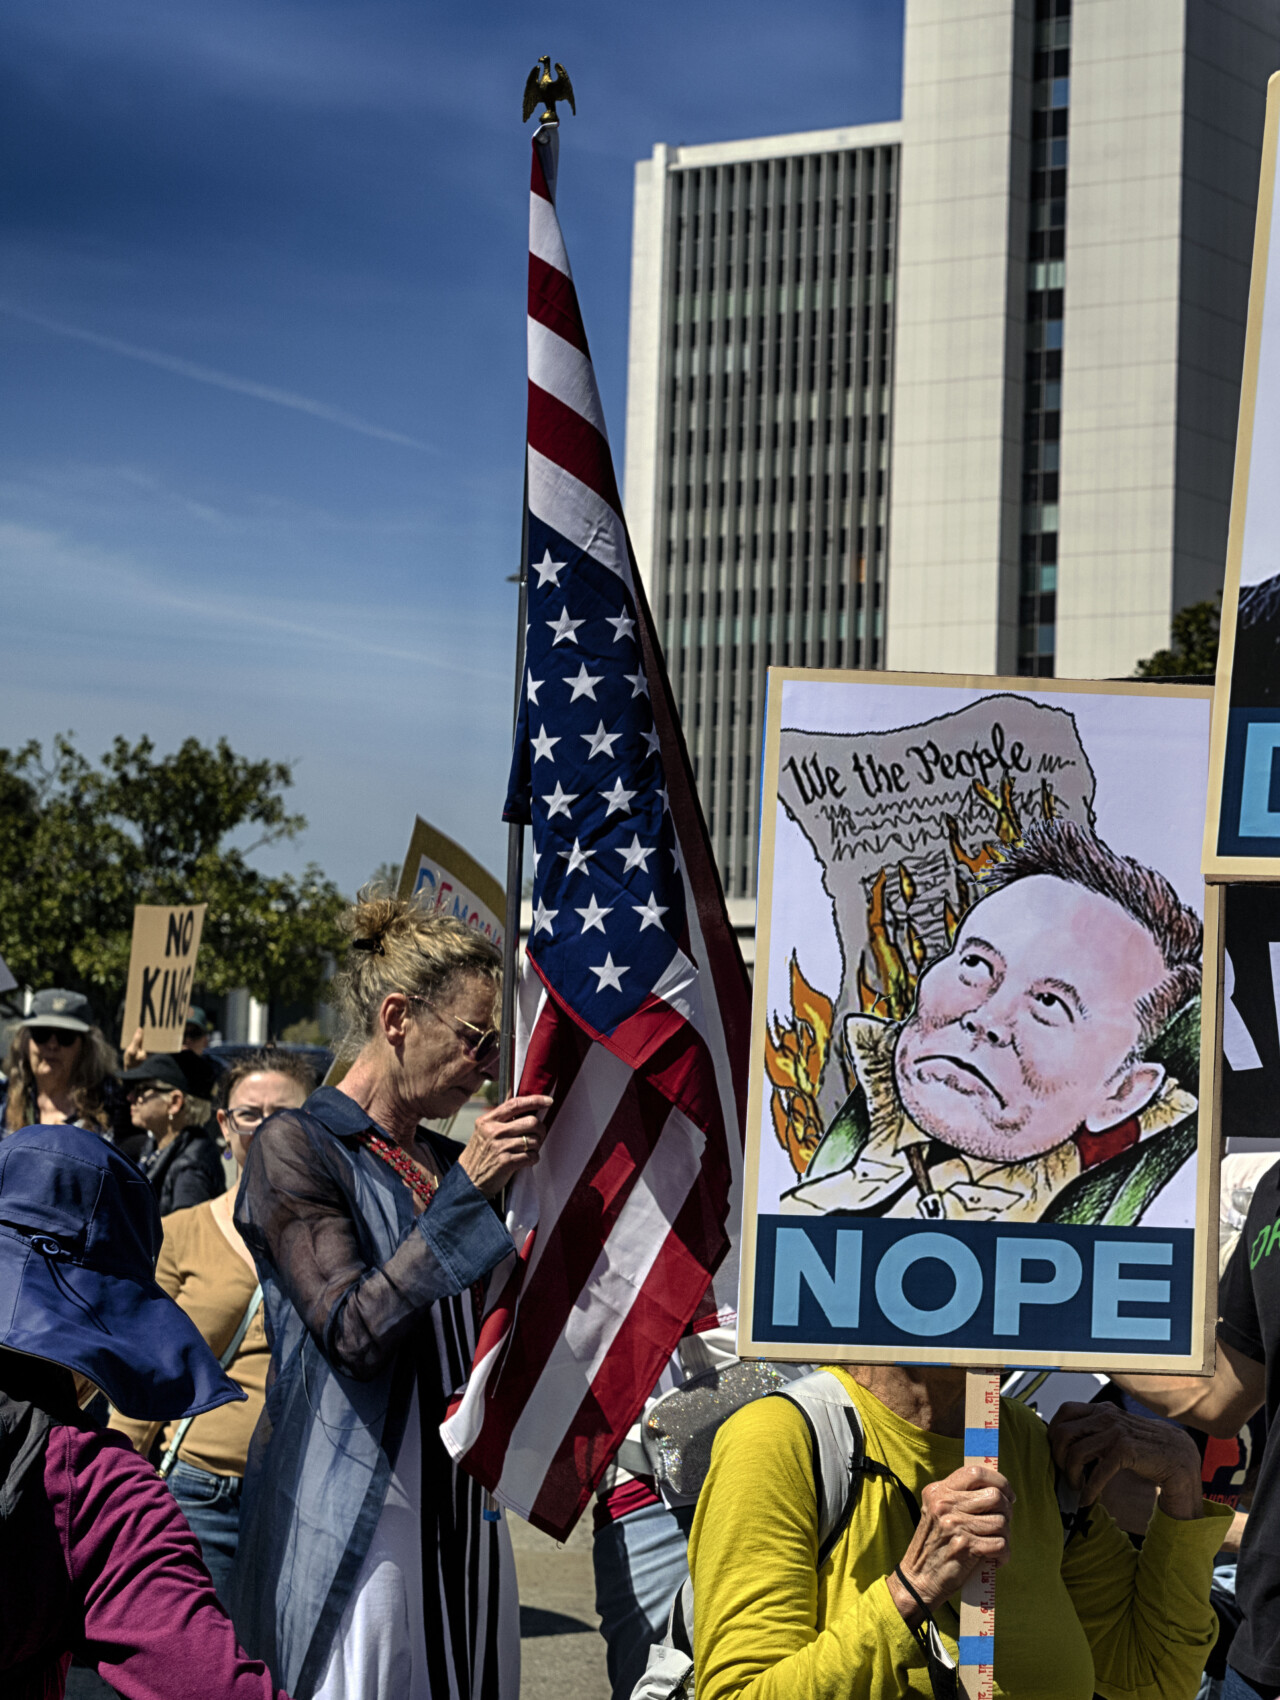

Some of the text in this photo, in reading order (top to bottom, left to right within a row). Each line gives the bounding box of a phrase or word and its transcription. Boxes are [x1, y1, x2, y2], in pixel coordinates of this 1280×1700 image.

[782, 723, 1031, 805] We the People
[165, 910, 194, 957] NO
[139, 965, 192, 1029] KING
[772, 1227, 1173, 1340] NOPE
[985, 1391, 994, 1404] 12
[981, 1571, 989, 1584] 18
[980, 1601, 988, 1614] 19
